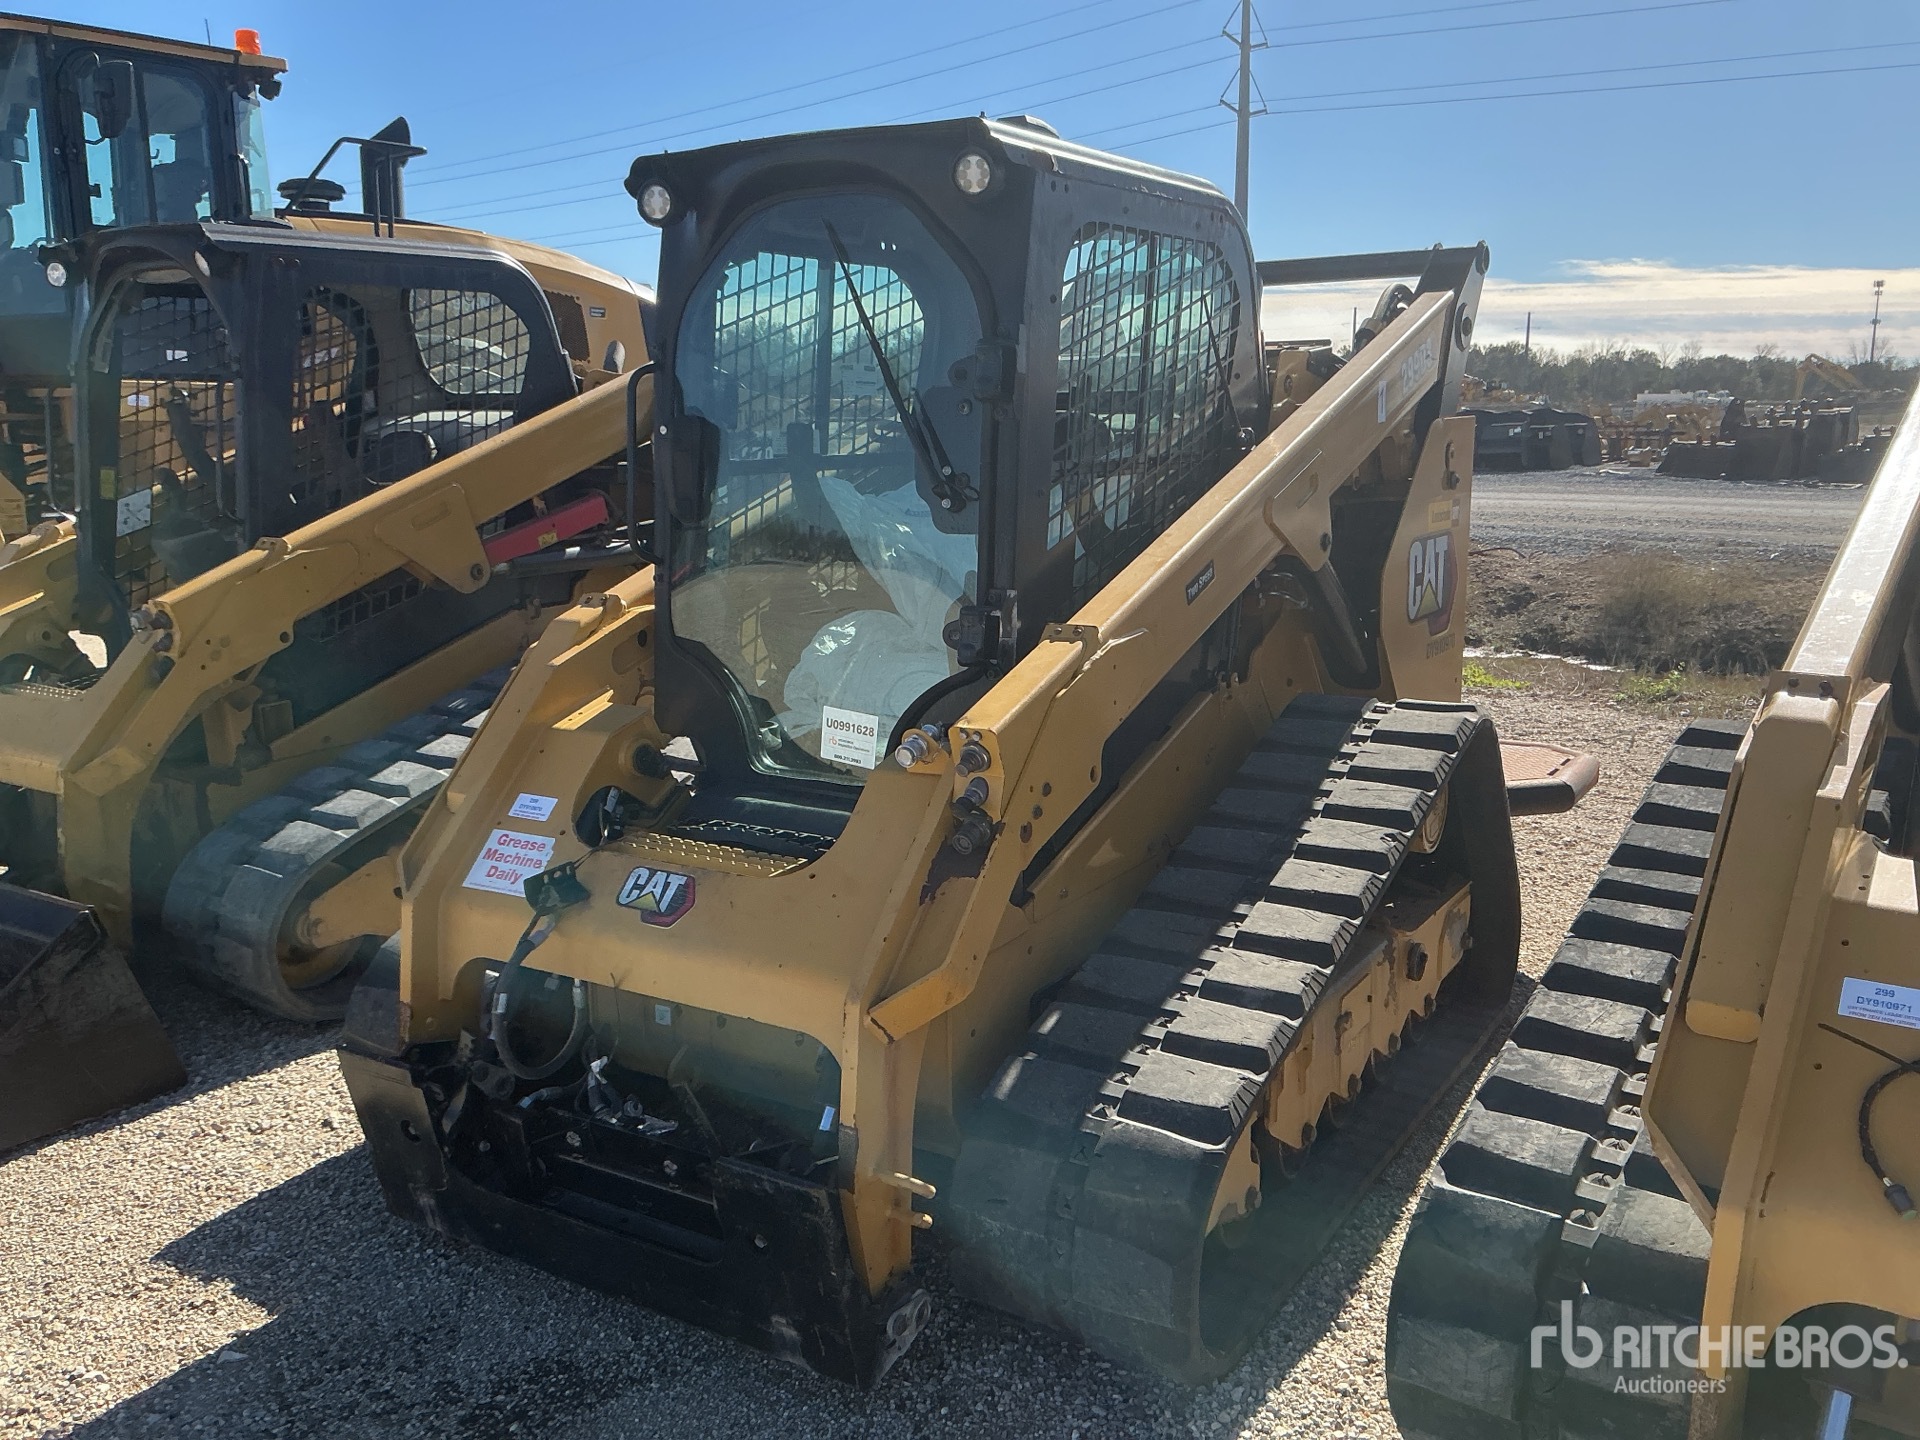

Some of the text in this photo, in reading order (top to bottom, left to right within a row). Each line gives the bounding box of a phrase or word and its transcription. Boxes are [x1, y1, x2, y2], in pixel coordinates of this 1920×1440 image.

[1407, 534, 1449, 620] CAT
[826, 717, 875, 737] U0991628
[497, 833, 546, 852] Grease
[482, 847, 543, 869] Machine
[485, 865, 523, 885] Daily
[618, 867, 688, 913] CAT
[1874, 987, 1896, 998] 299
